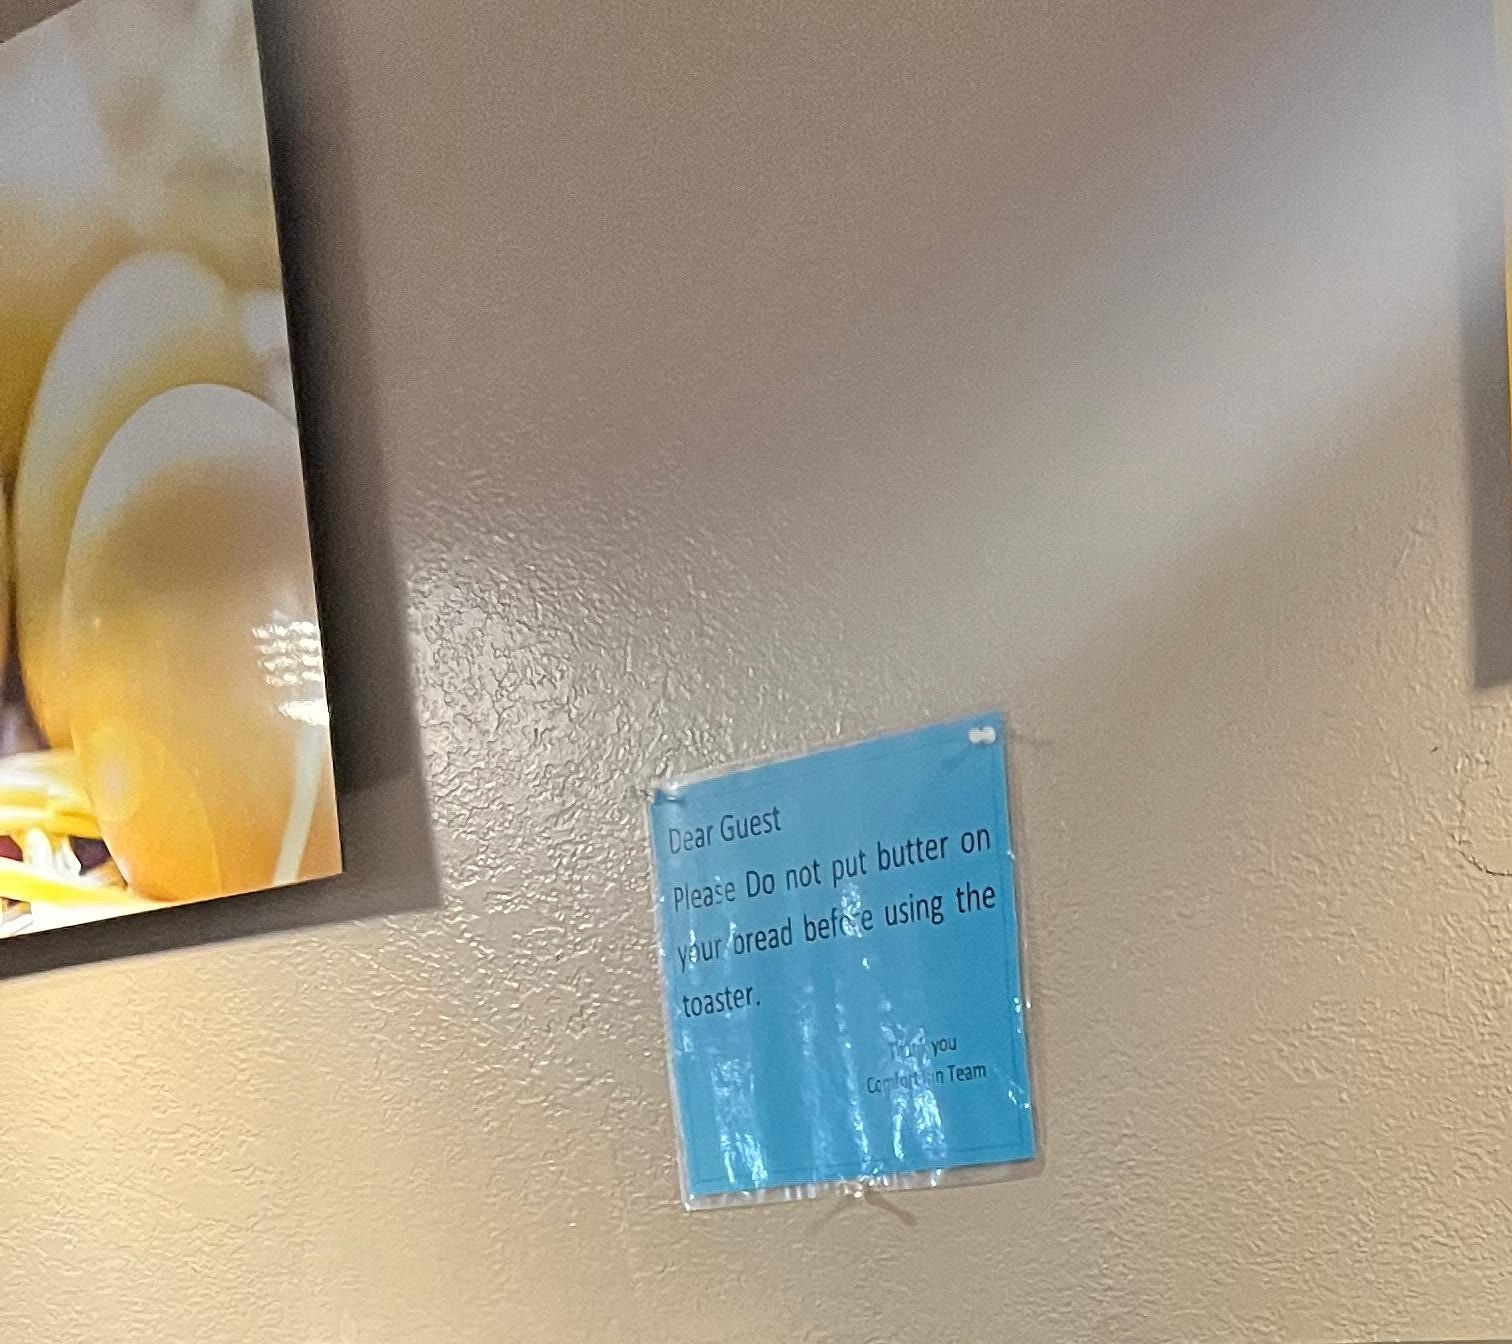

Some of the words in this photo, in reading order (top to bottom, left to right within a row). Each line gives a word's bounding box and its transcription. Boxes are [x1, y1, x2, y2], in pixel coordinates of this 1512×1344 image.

[669, 825, 713, 854] Dear
[720, 806, 781, 841] Guest
[674, 873, 735, 912] Please
[746, 870, 775, 897] Do
[786, 859, 821, 890] not
[832, 848, 866, 888] put
[877, 836, 948, 871] butter
[961, 828, 990, 853] on
[677, 938, 721, 973] your
[885, 893, 944, 925] using
[956, 882, 996, 913] the
[682, 987, 761, 1018] toaster.
[931, 1038, 957, 1057] you
[947, 1065, 987, 1083] Team
